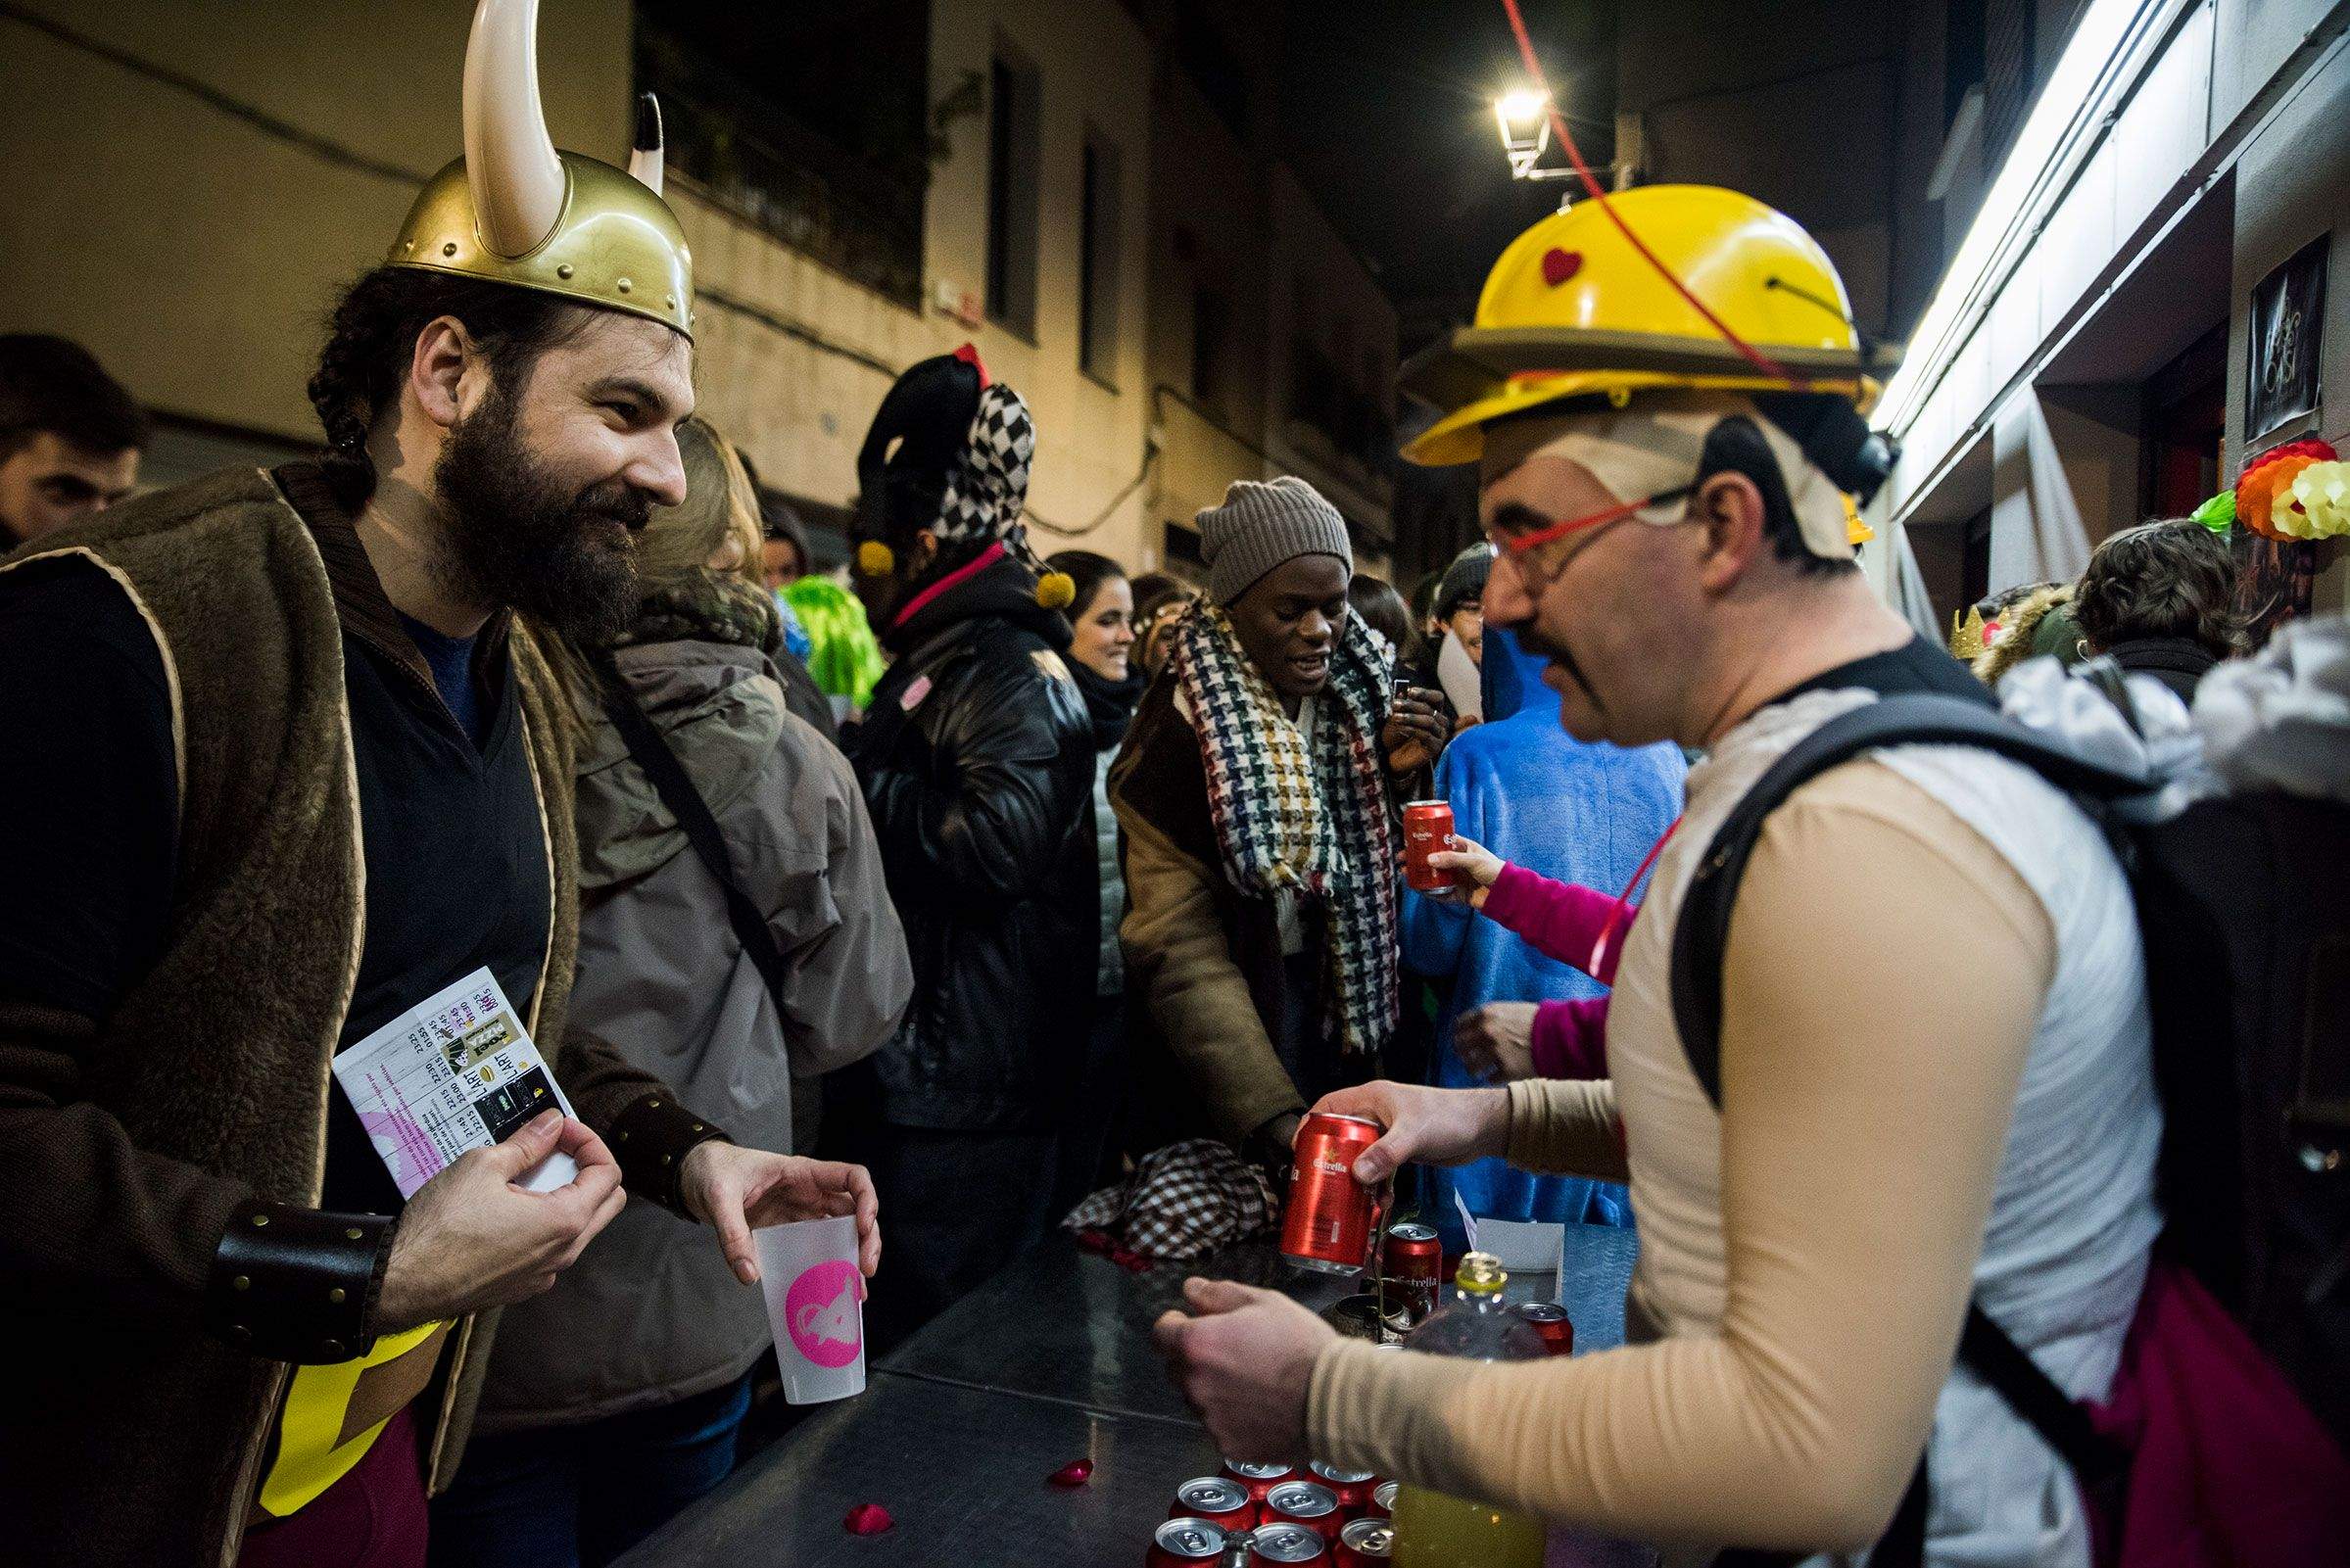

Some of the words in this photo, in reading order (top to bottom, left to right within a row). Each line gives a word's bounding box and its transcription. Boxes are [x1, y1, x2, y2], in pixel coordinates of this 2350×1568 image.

[482, 986, 499, 1009] 00:15
[450, 1006, 466, 1028] 23:45
[458, 1000, 476, 1022] 01:30
[416, 1025, 434, 1048] 01:55
[427, 1019, 445, 1040] 23:45
[467, 1022, 504, 1048] PIZZA
[407, 1032, 424, 1054] 23:25
[424, 1062, 441, 1083] 22:30
[434, 1055, 451, 1077] 23:15
[494, 1050, 518, 1079] L'ART
[449, 1081, 466, 1104] 23:00
[462, 1068, 487, 1098] L'ART
[439, 1088, 456, 1110] 22:15
[456, 1116, 472, 1137] 21:45
[465, 1109, 483, 1131] 22:15
